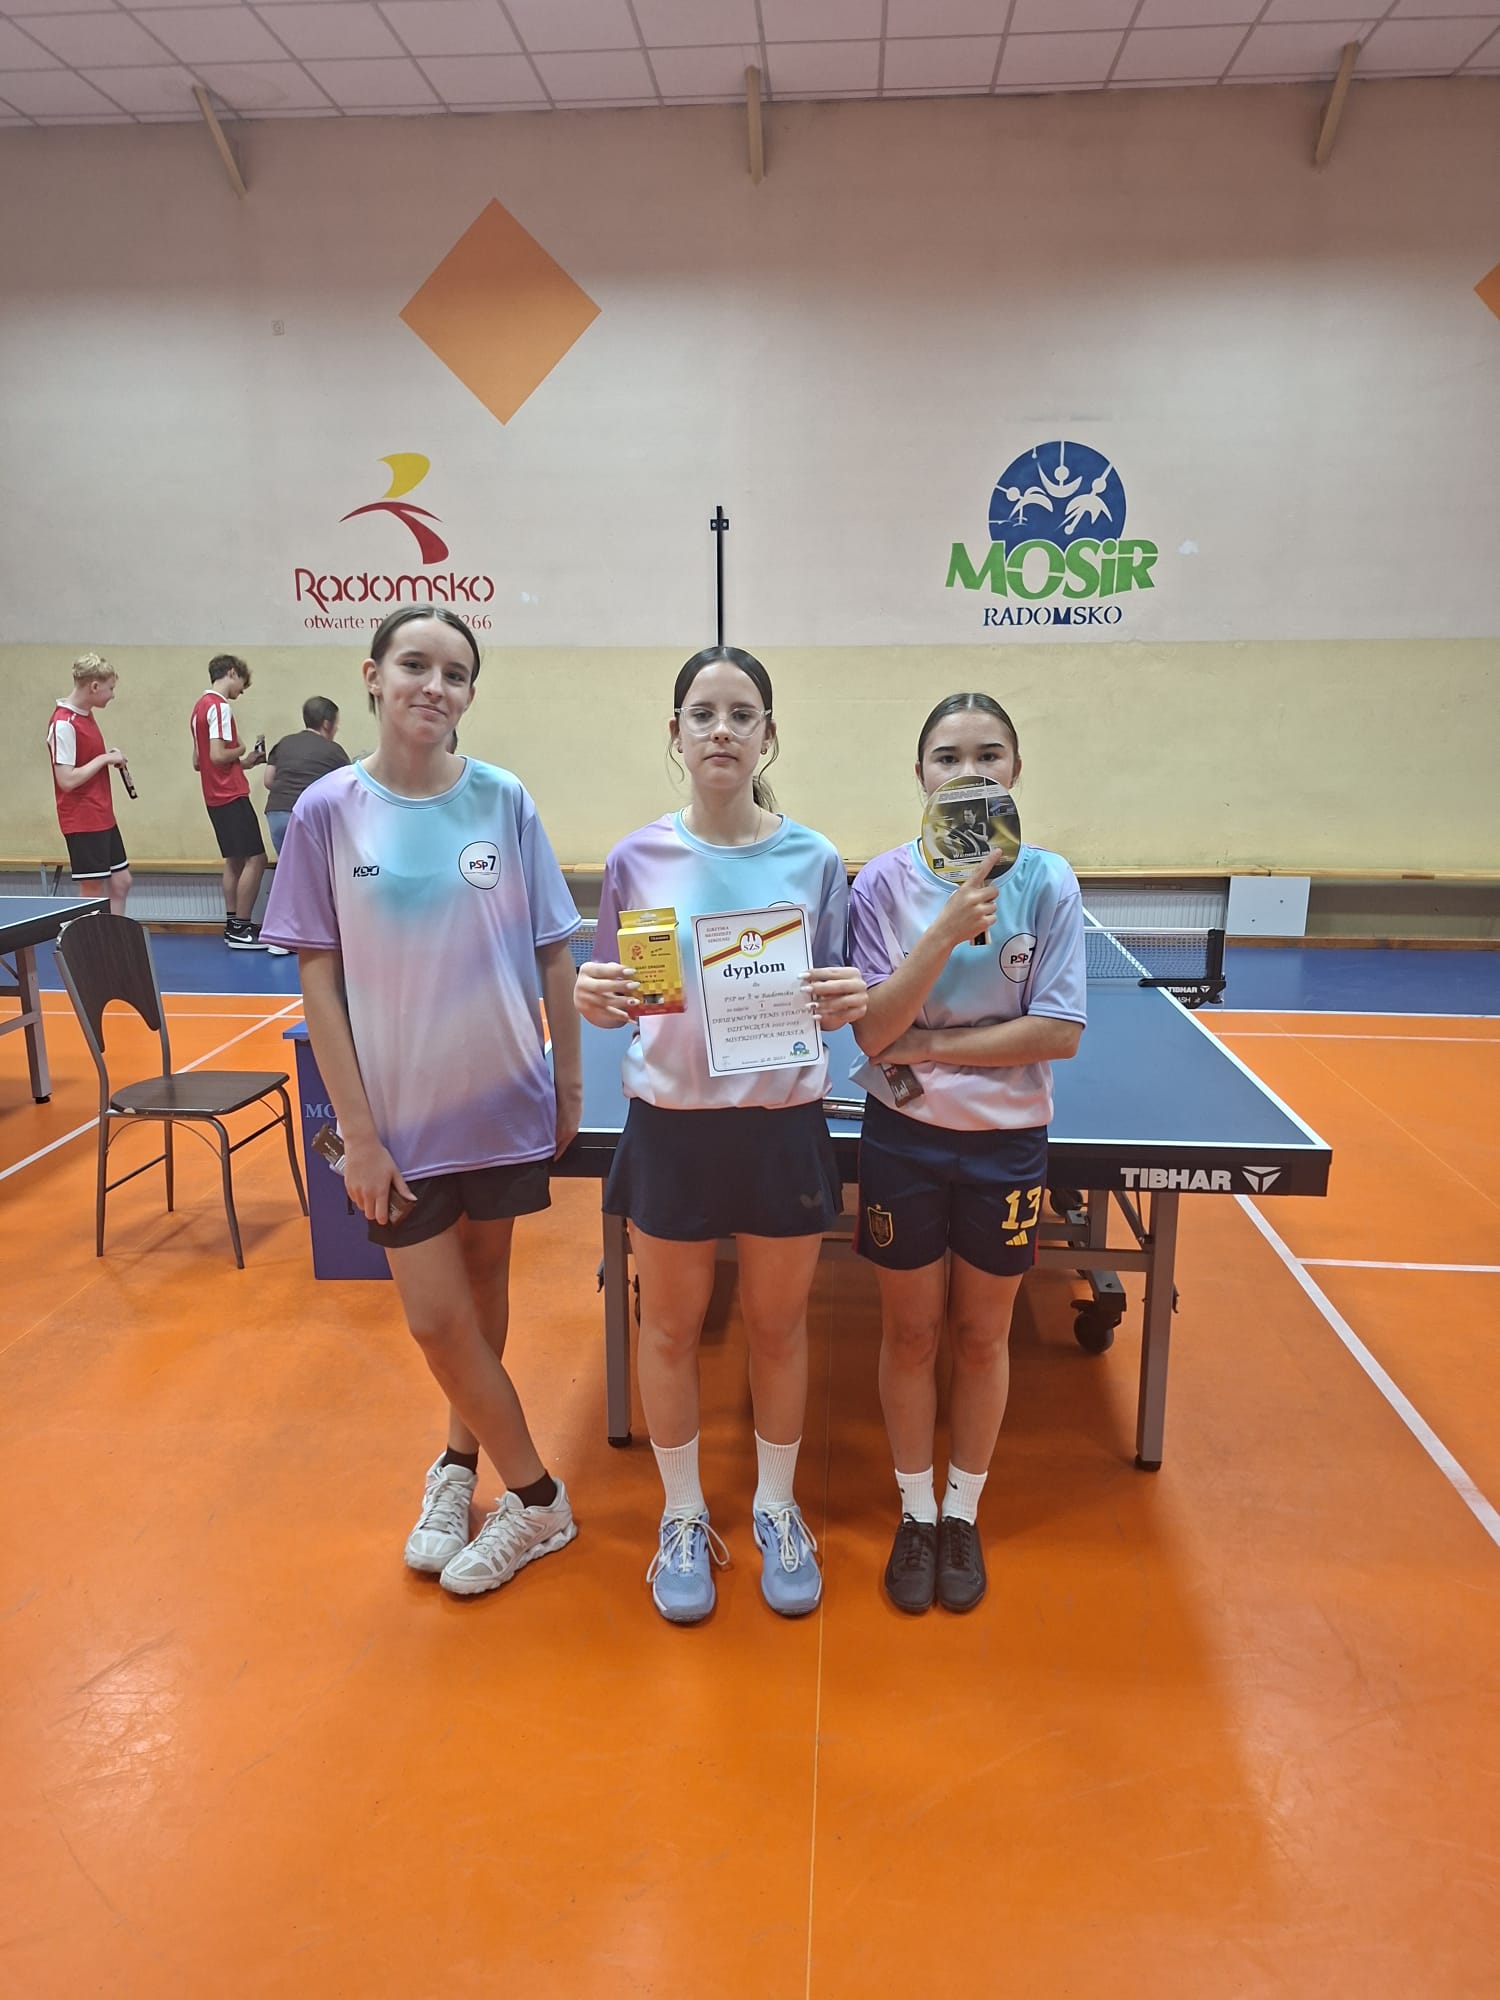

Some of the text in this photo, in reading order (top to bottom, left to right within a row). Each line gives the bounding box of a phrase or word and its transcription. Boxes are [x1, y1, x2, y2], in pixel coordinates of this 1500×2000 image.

[945, 538, 1159, 600] MOSiR
[294, 568, 495, 614] Radomsko
[304, 614, 365, 629] otwarte
[457, 614, 492, 629] 266
[983, 606, 1123, 626] RADOMSKO
[723, 961, 786, 980] dyplom
[1167, 986, 1198, 994] TIBHAR
[304, 1103, 337, 1119] MO
[1120, 1167, 1232, 1191] TIBHAR
[1001, 1185, 1042, 1230] 13
